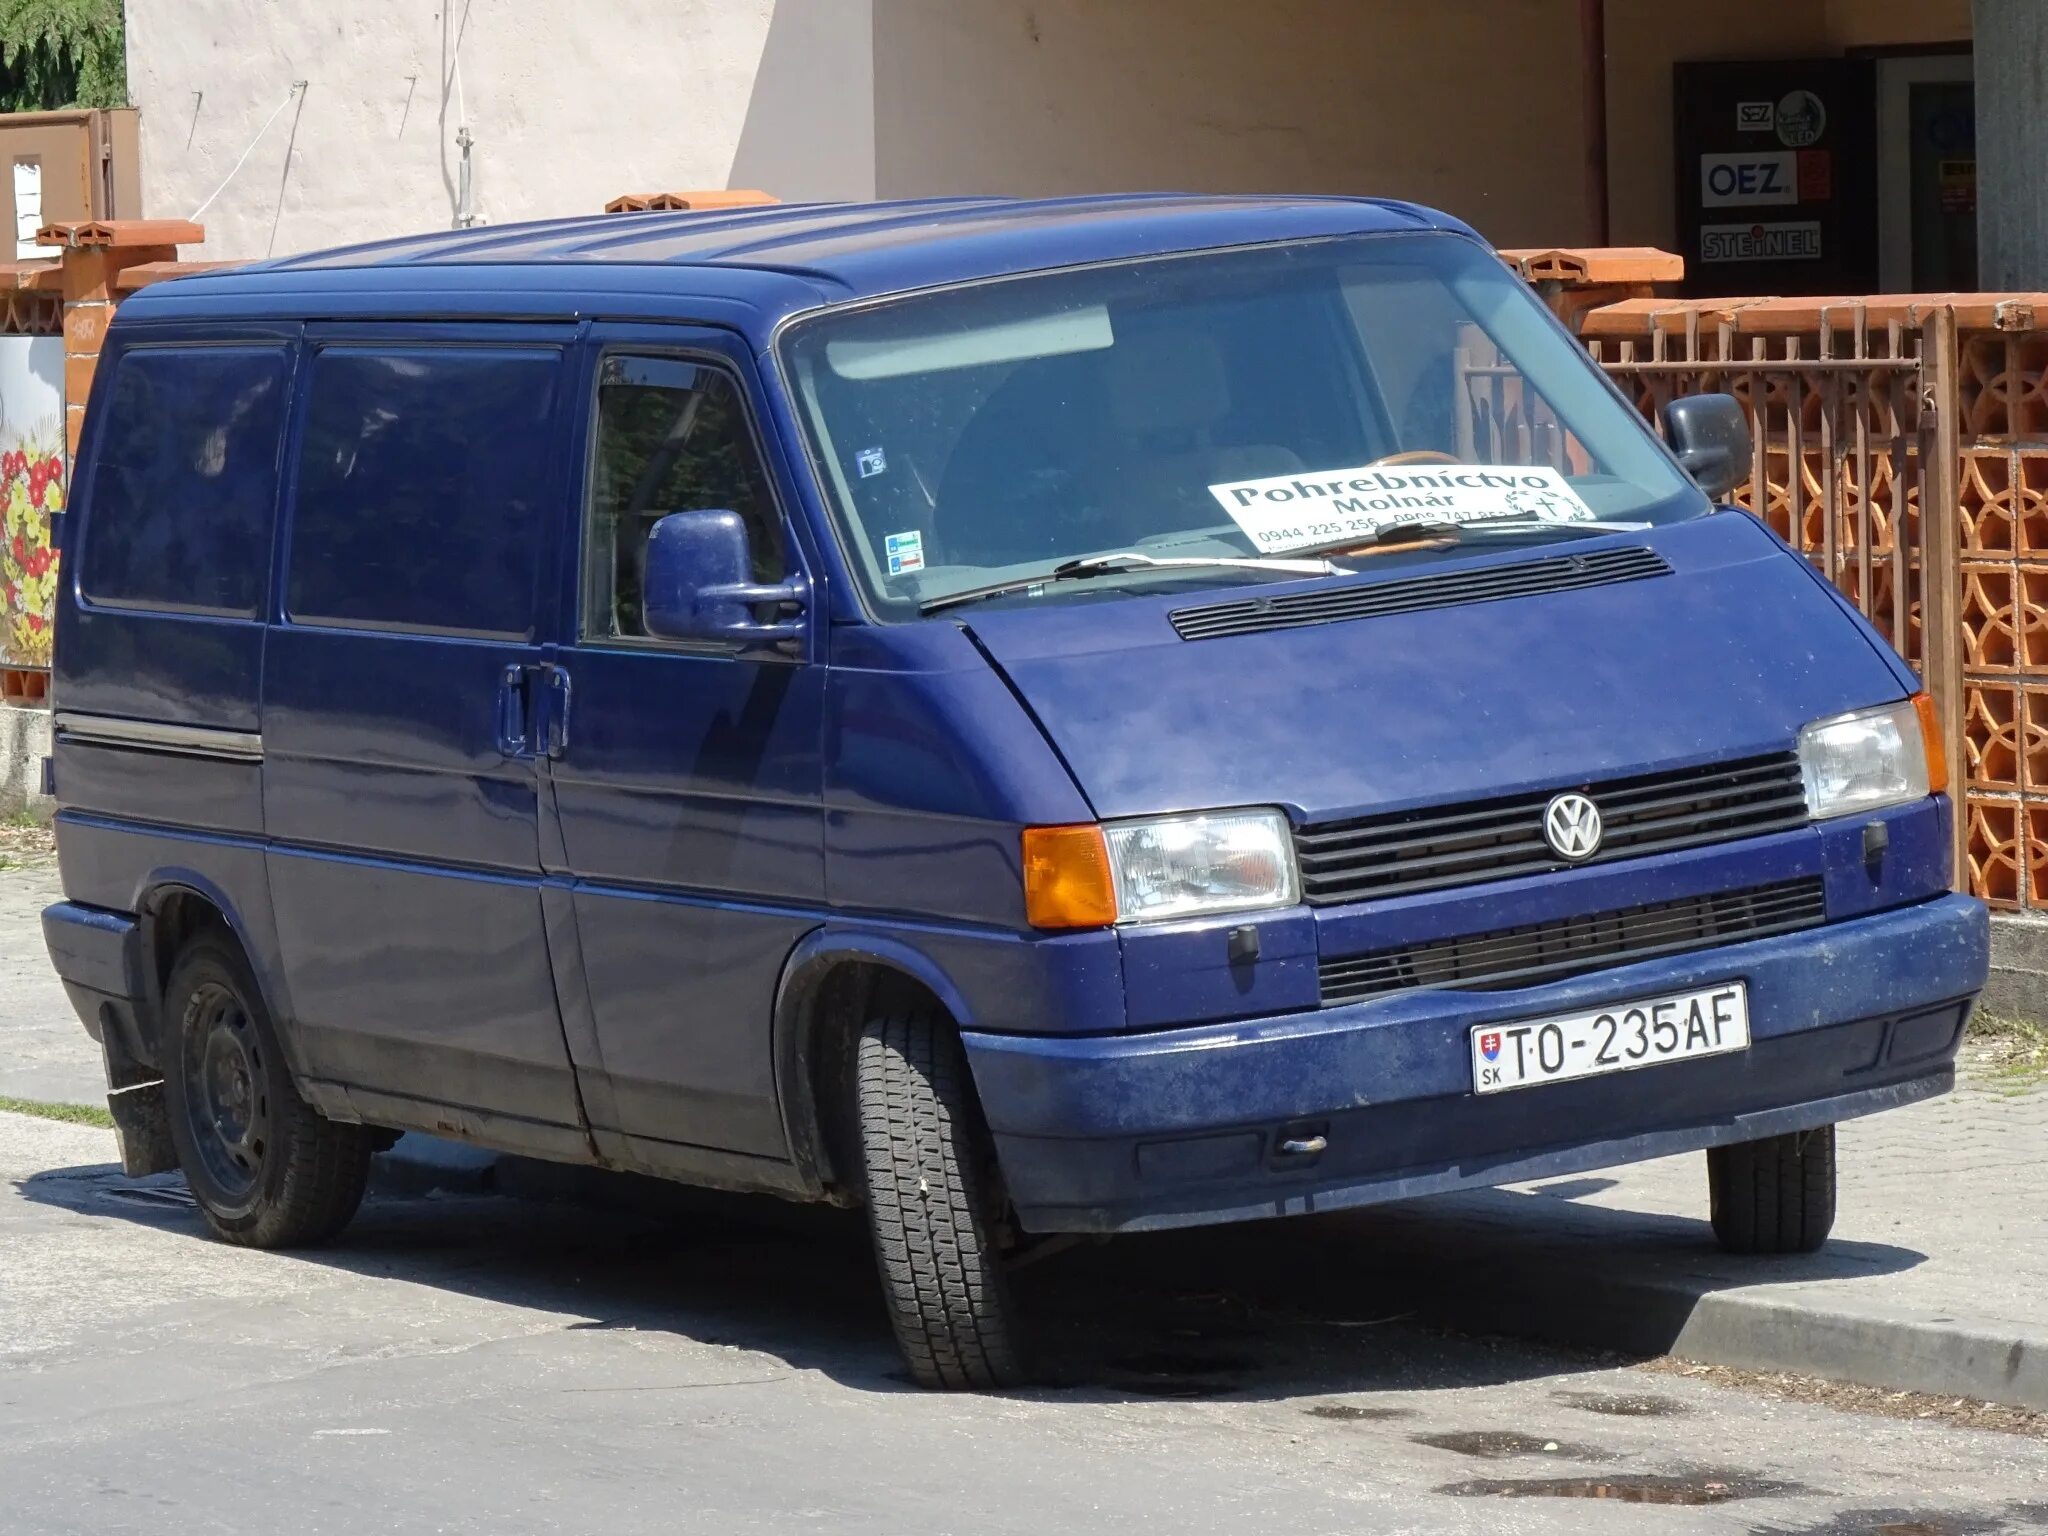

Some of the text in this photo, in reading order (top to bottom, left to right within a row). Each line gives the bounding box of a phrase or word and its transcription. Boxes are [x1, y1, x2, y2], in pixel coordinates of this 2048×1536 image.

[1708, 163, 1782, 196] OEZ
[1230, 470, 1550, 507] Pohrebníctvo
[1332, 491, 1455, 514] Molnár
[1258, 527, 1304, 542] 0944
[1307, 522, 1342, 536] 225
[1345, 517, 1382, 531] 256
[1506, 991, 1737, 1080] TO-235AF
[1482, 1067, 1502, 1086] SK
